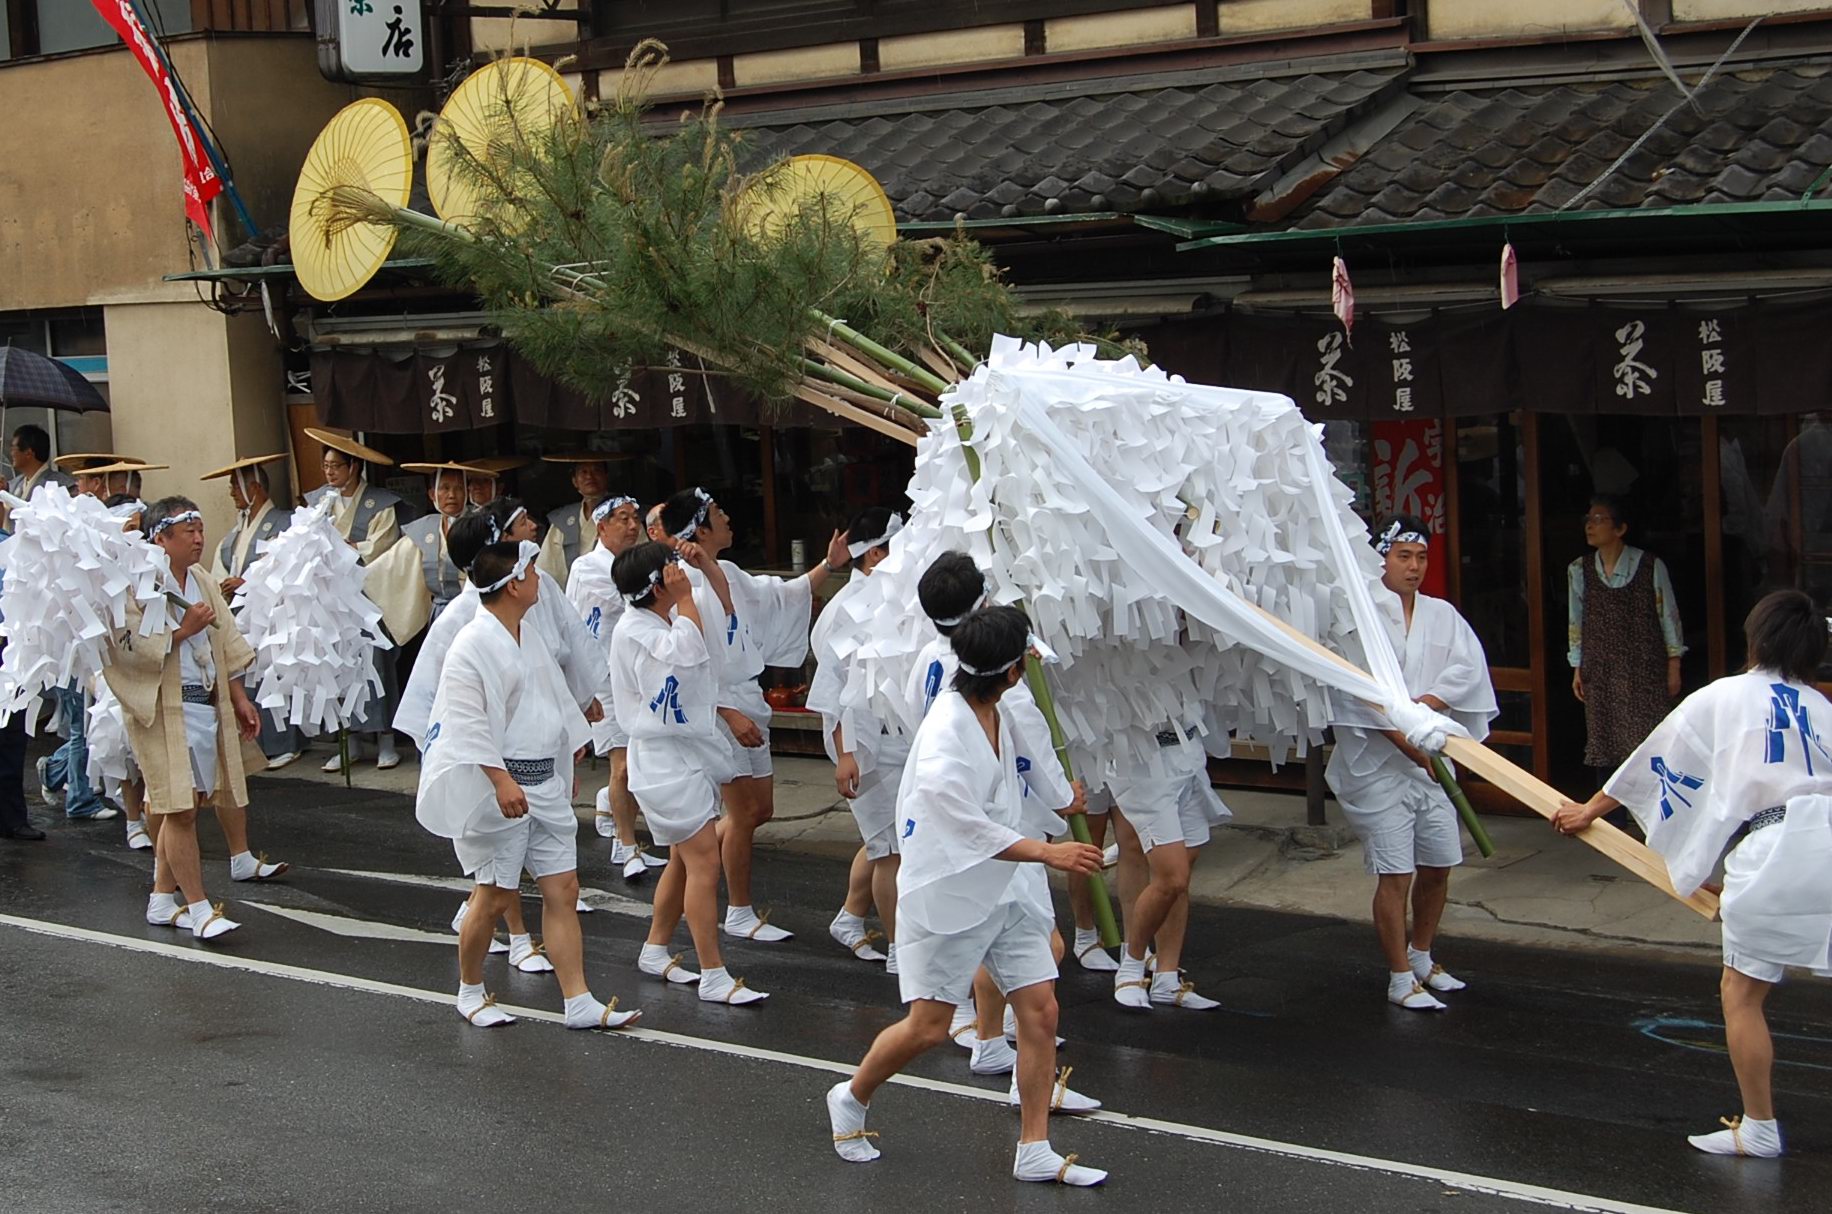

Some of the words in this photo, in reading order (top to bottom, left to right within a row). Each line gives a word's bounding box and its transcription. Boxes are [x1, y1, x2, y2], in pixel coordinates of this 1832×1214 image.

[381, 4, 414, 58] 店
[428, 365, 457, 423] 茶
[476, 355, 495, 418] 松阪屋
[1314, 331, 1354, 406] 茶
[1389, 331, 1415, 412] 松阪屋
[1613, 320, 1658, 399] 茶
[1698, 318, 1726, 406] 松阪屋
